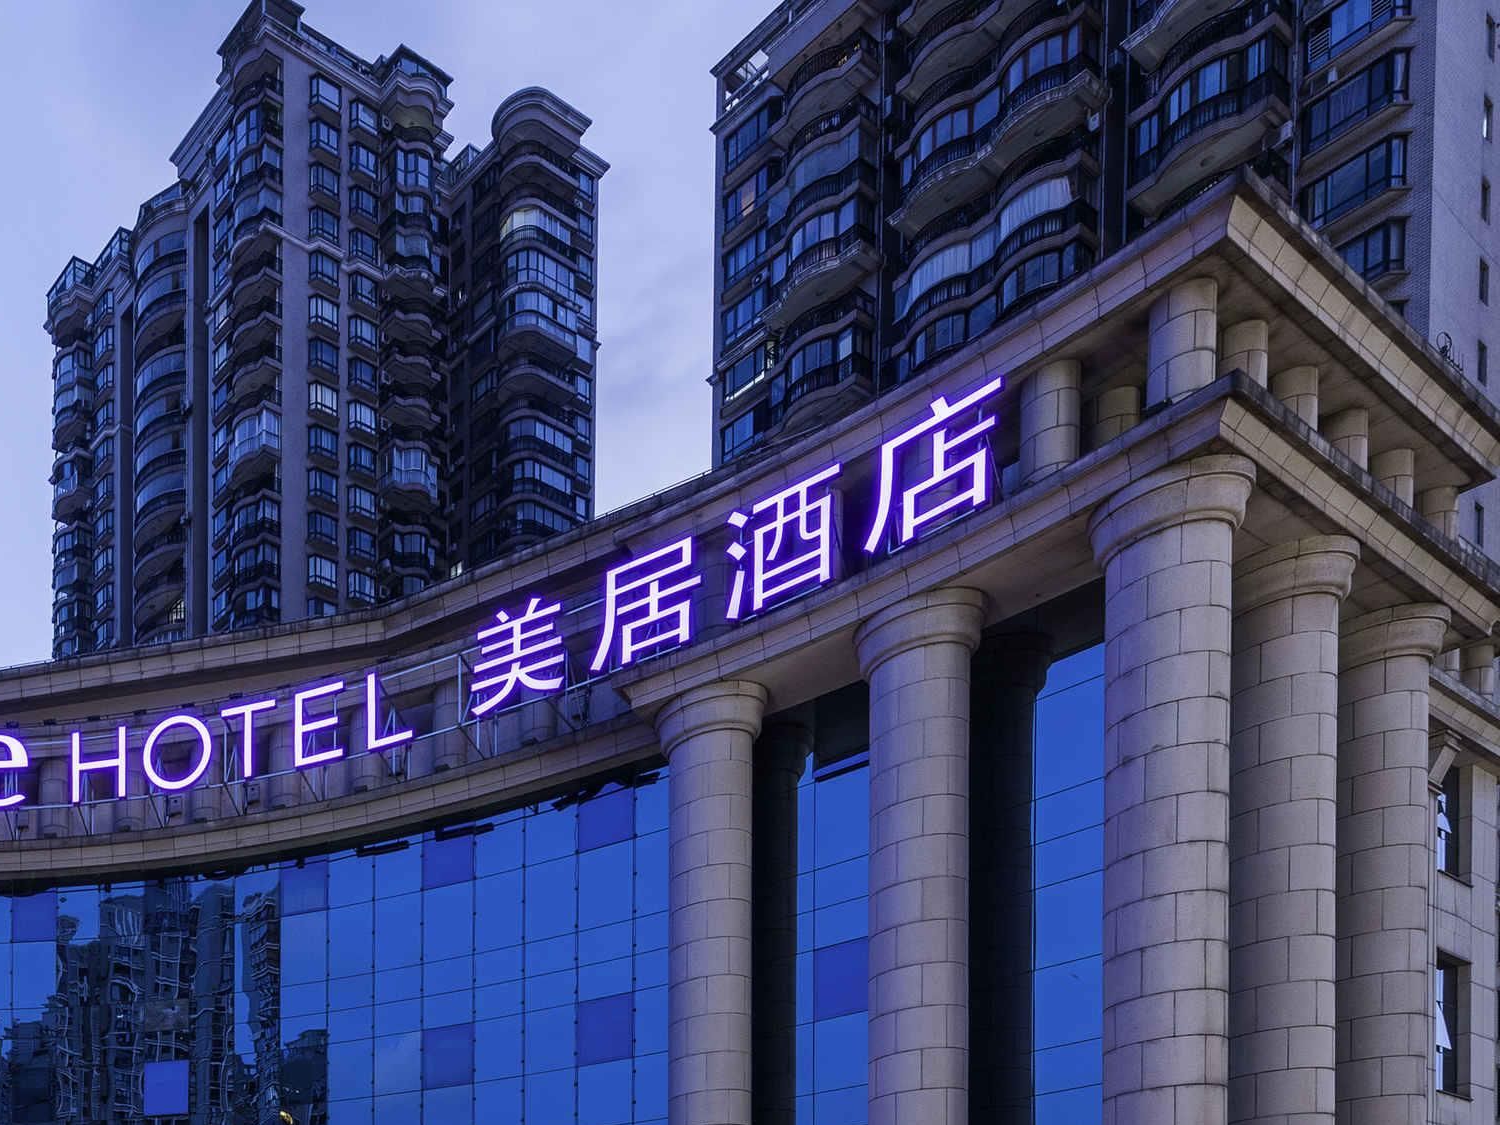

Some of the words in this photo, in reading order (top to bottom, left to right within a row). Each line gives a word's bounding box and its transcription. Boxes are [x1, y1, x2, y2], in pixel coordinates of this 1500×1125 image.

[470, 375, 1003, 716] 美居酒店
[70, 672, 415, 805] HOTEL
